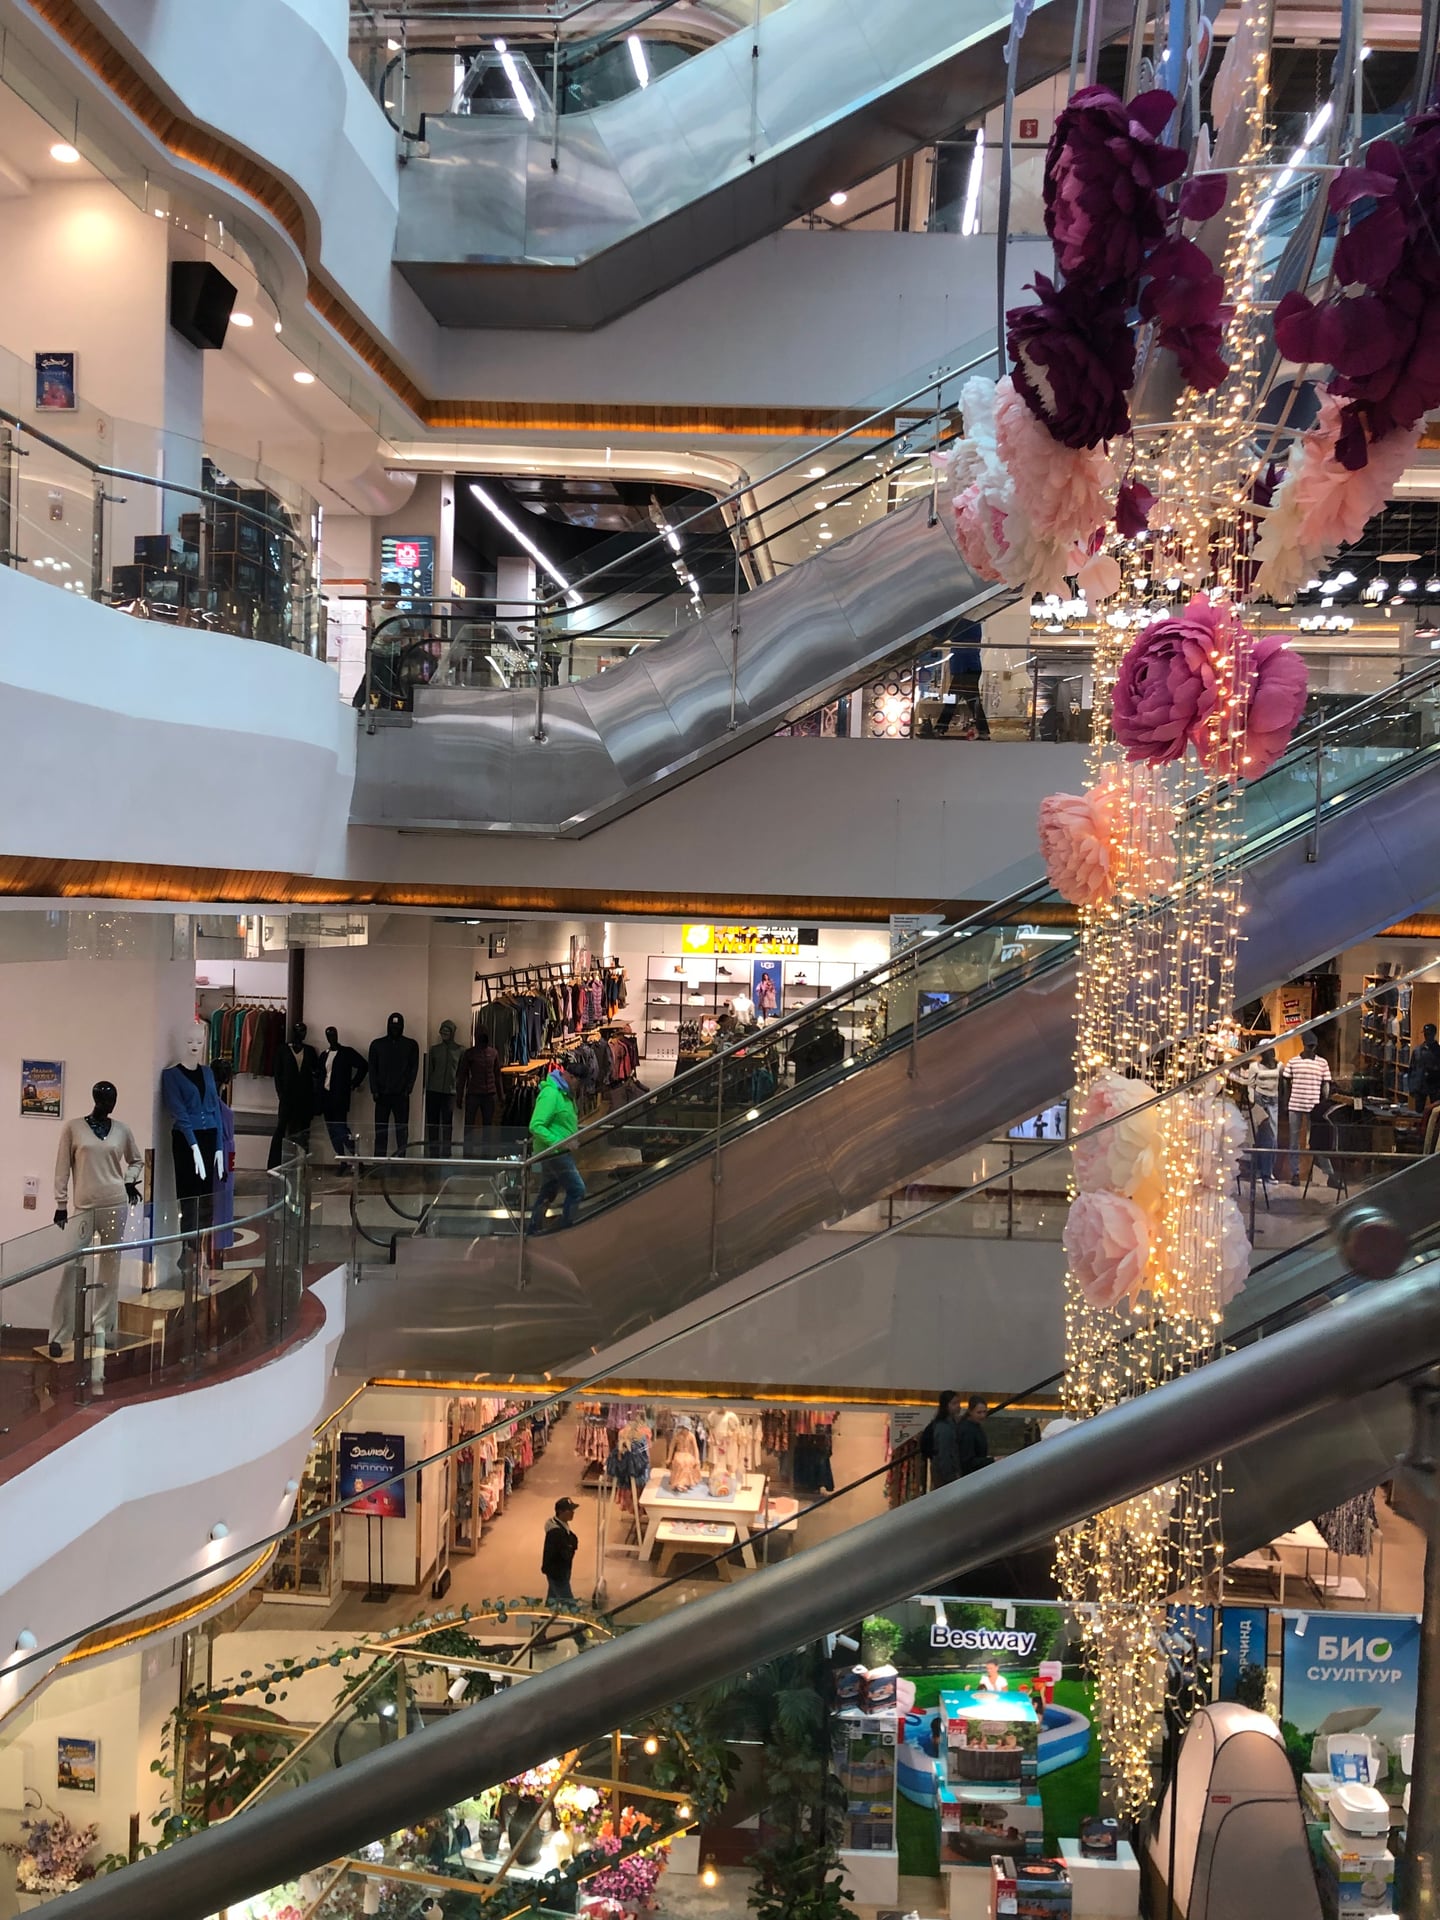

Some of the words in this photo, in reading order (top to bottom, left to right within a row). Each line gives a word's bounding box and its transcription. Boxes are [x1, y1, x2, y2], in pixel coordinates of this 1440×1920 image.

[931, 1624, 1036, 1656] Bestway
[1318, 1636, 1393, 1663] БИО
[1306, 1666, 1402, 1683] СУУЛТУУР
